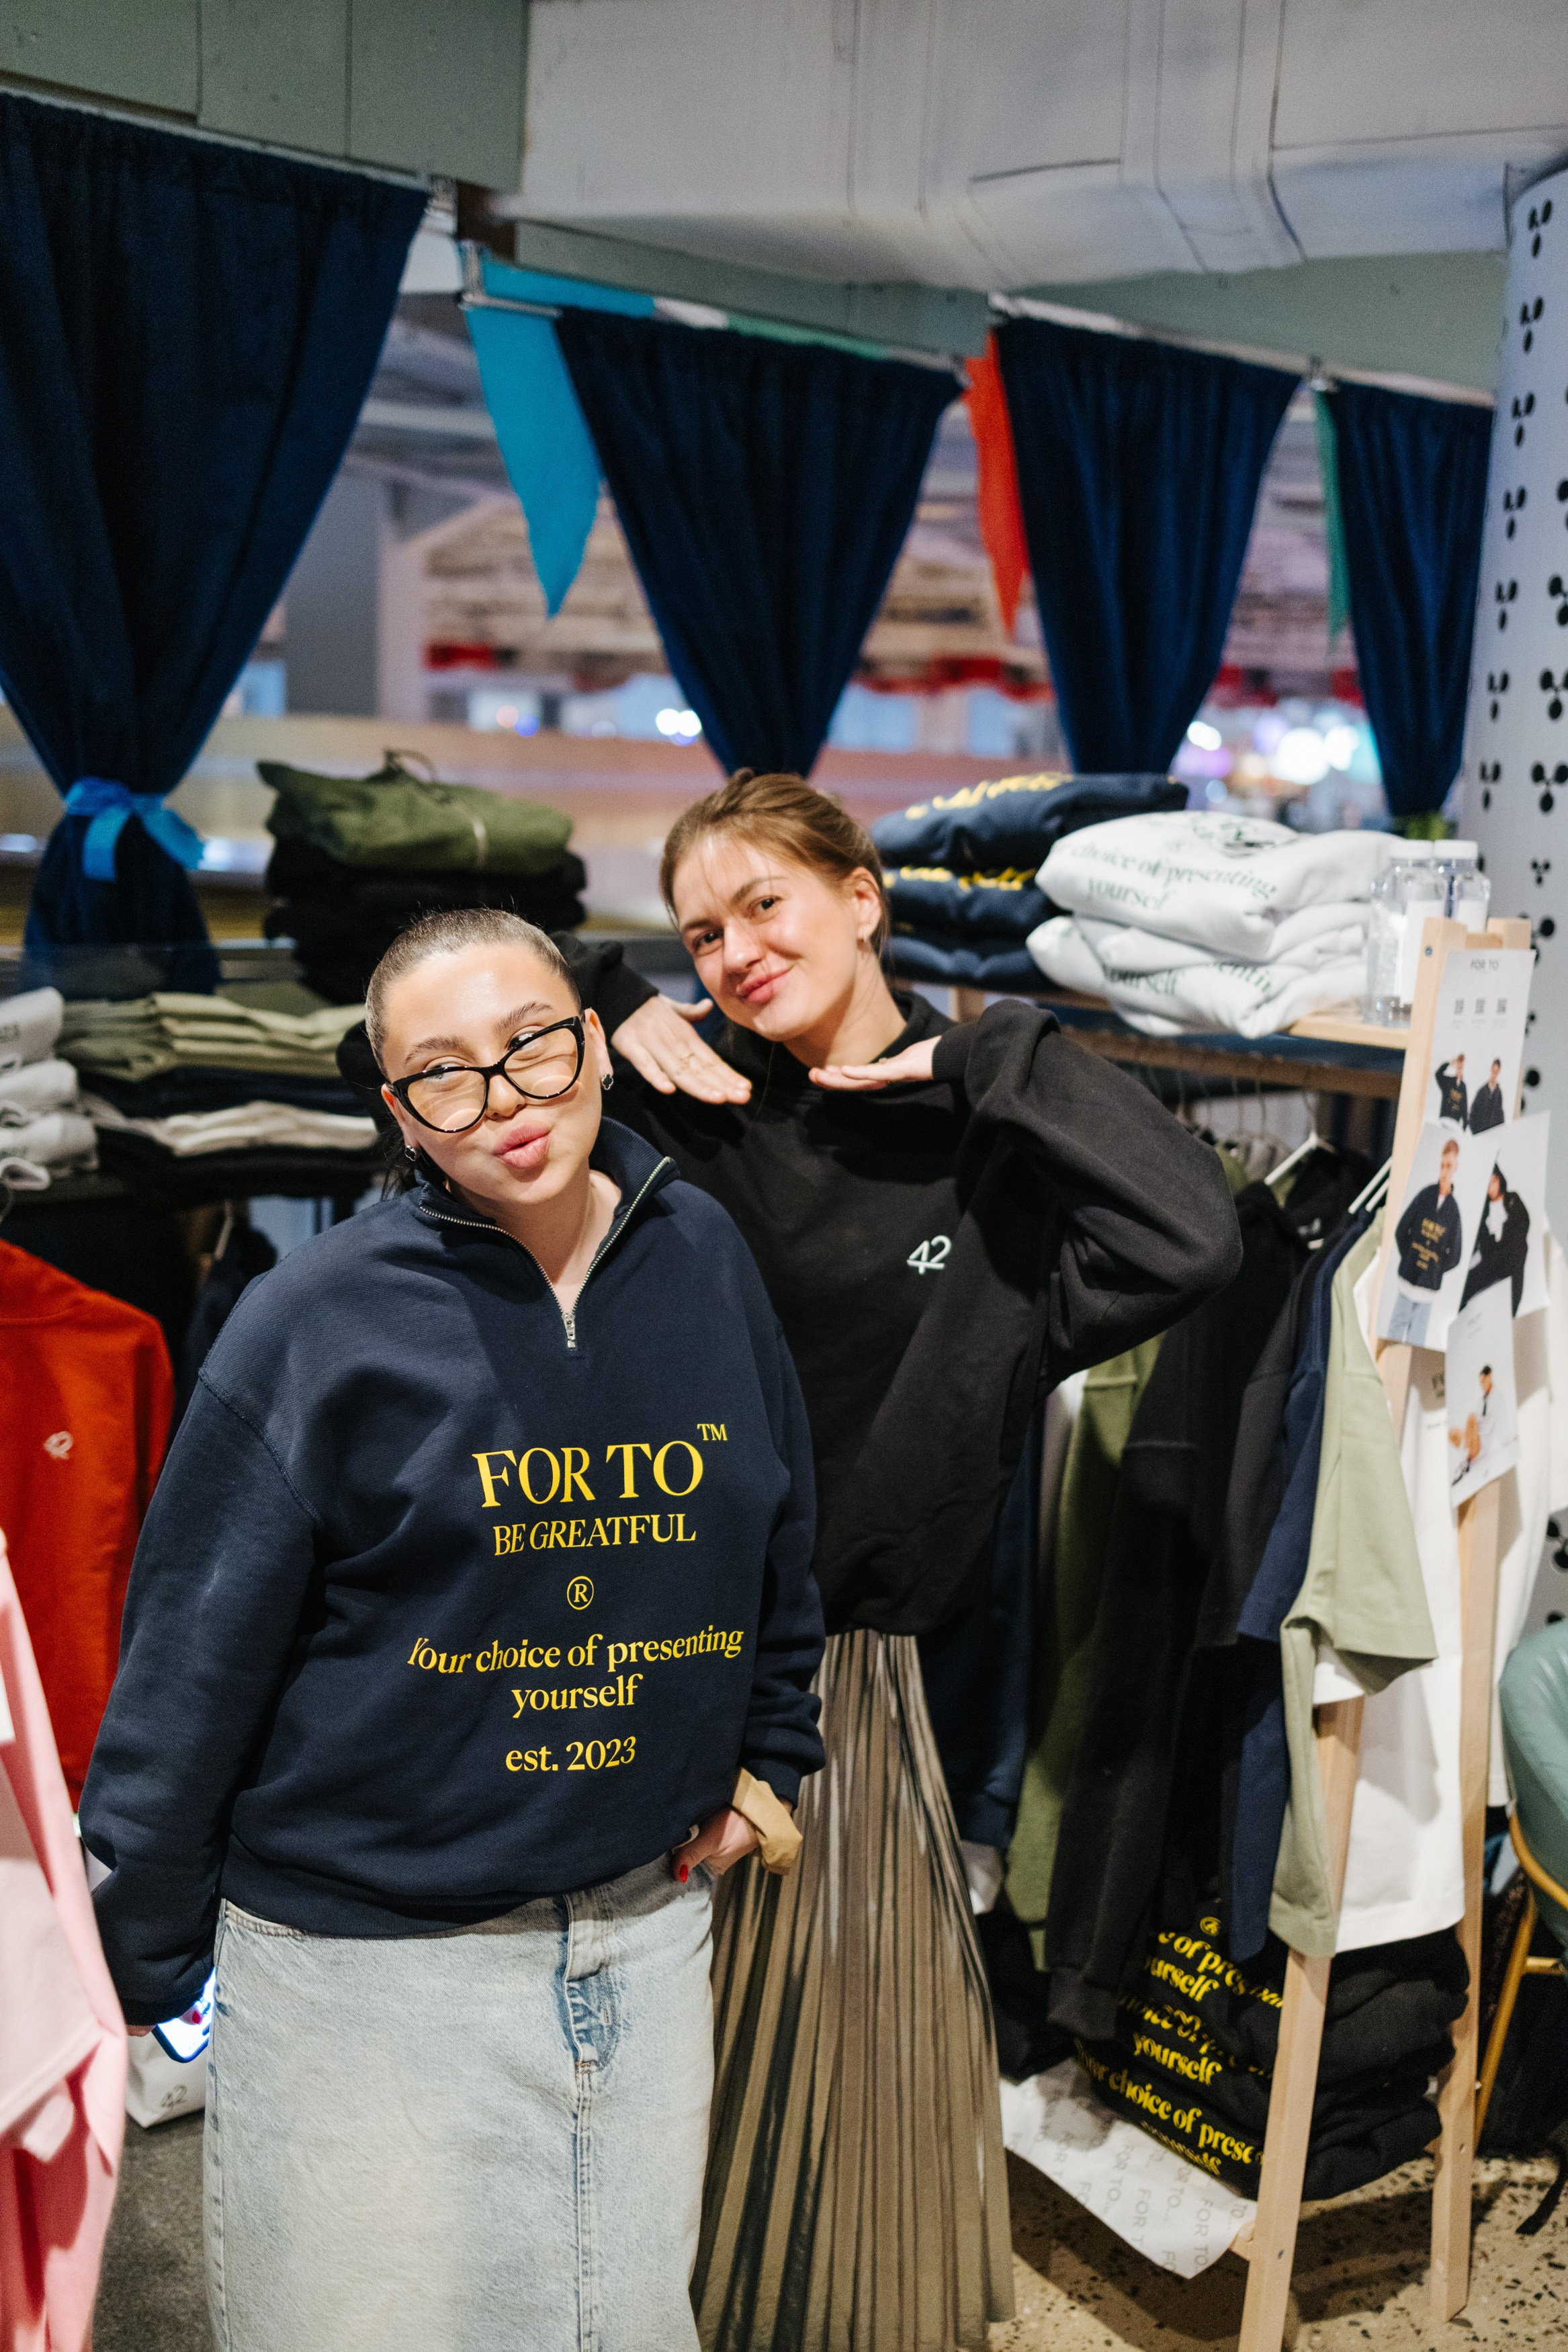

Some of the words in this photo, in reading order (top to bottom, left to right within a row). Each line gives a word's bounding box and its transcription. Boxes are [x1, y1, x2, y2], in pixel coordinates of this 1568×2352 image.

[906, 1234, 952, 1275] 42
[472, 1447, 596, 1508] FOR
[605, 1440, 704, 1499] TO
[493, 1523, 526, 1556] BE
[529, 1513, 697, 1550] GREATFUL
[407, 1637, 472, 1674] Your
[475, 1639, 561, 1673] choice
[567, 1634, 604, 1668] of
[607, 1624, 744, 1673] presenting
[511, 1673, 644, 1719] yourself
[505, 1746, 559, 1772] est.
[566, 1735, 636, 1772] 2023
[1146, 1958, 1220, 2002] urself
[1133, 2032, 1223, 2085] yourself
[1109, 2069, 1172, 2120] choice
[1173, 2107, 1203, 2134] of
